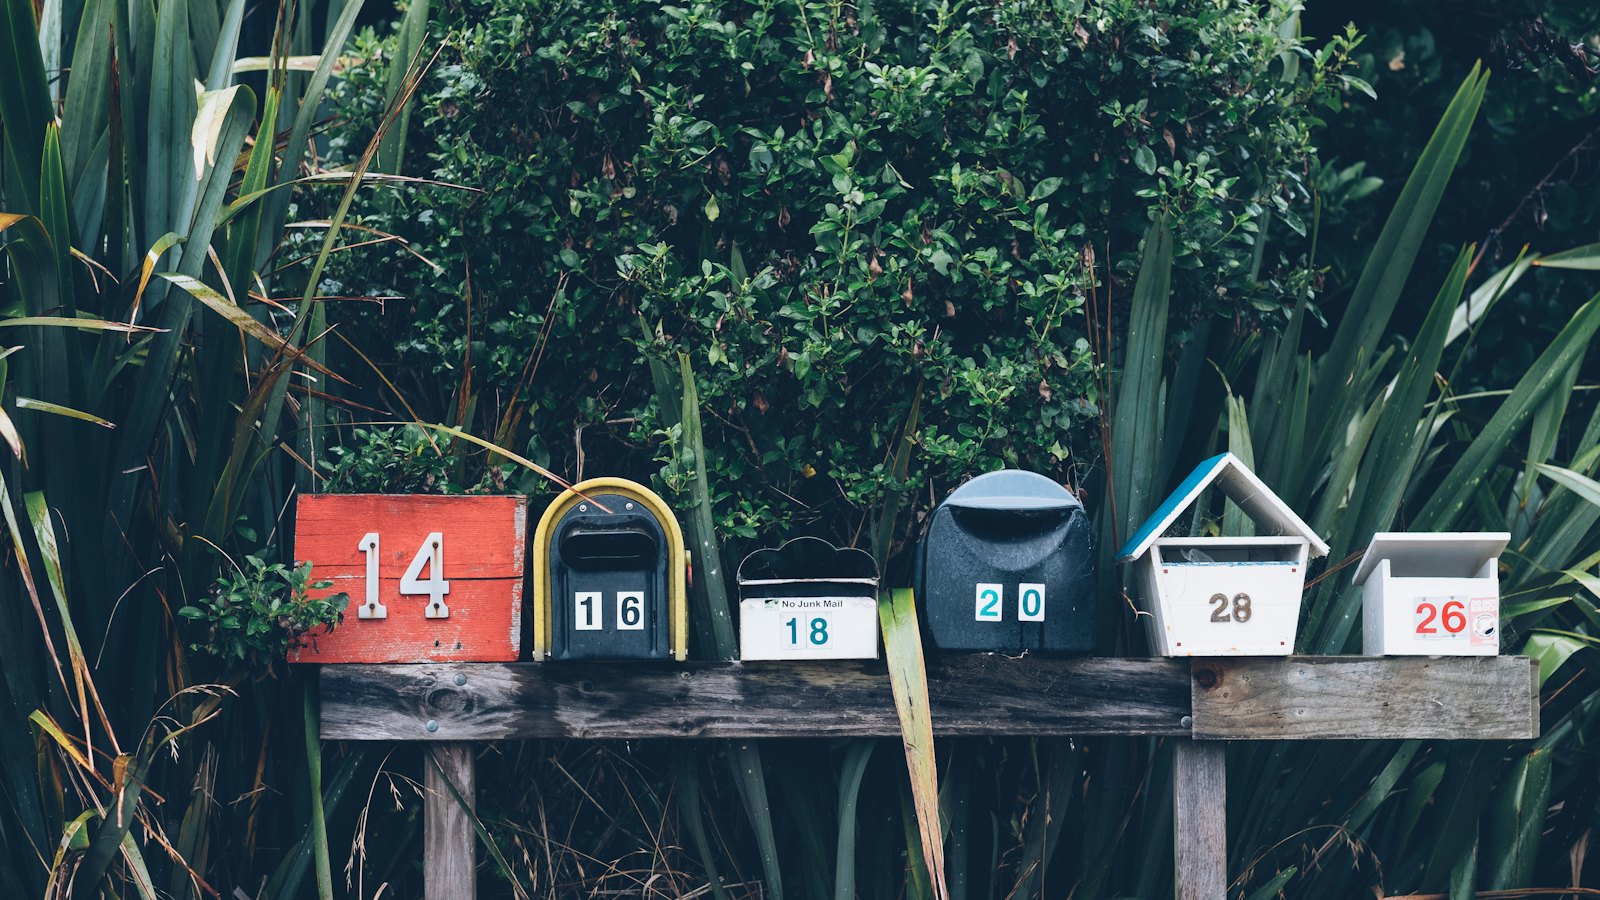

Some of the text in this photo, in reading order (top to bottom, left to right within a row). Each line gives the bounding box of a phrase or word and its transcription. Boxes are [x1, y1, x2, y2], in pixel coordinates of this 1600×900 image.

[358, 532, 450, 619] 14
[782, 600, 796, 608] No
[797, 600, 821, 608] Junk
[823, 600, 843, 608] Mail
[1209, 592, 1252, 623] 28
[1415, 600, 1467, 634] 26
[786, 617, 829, 645] 18
